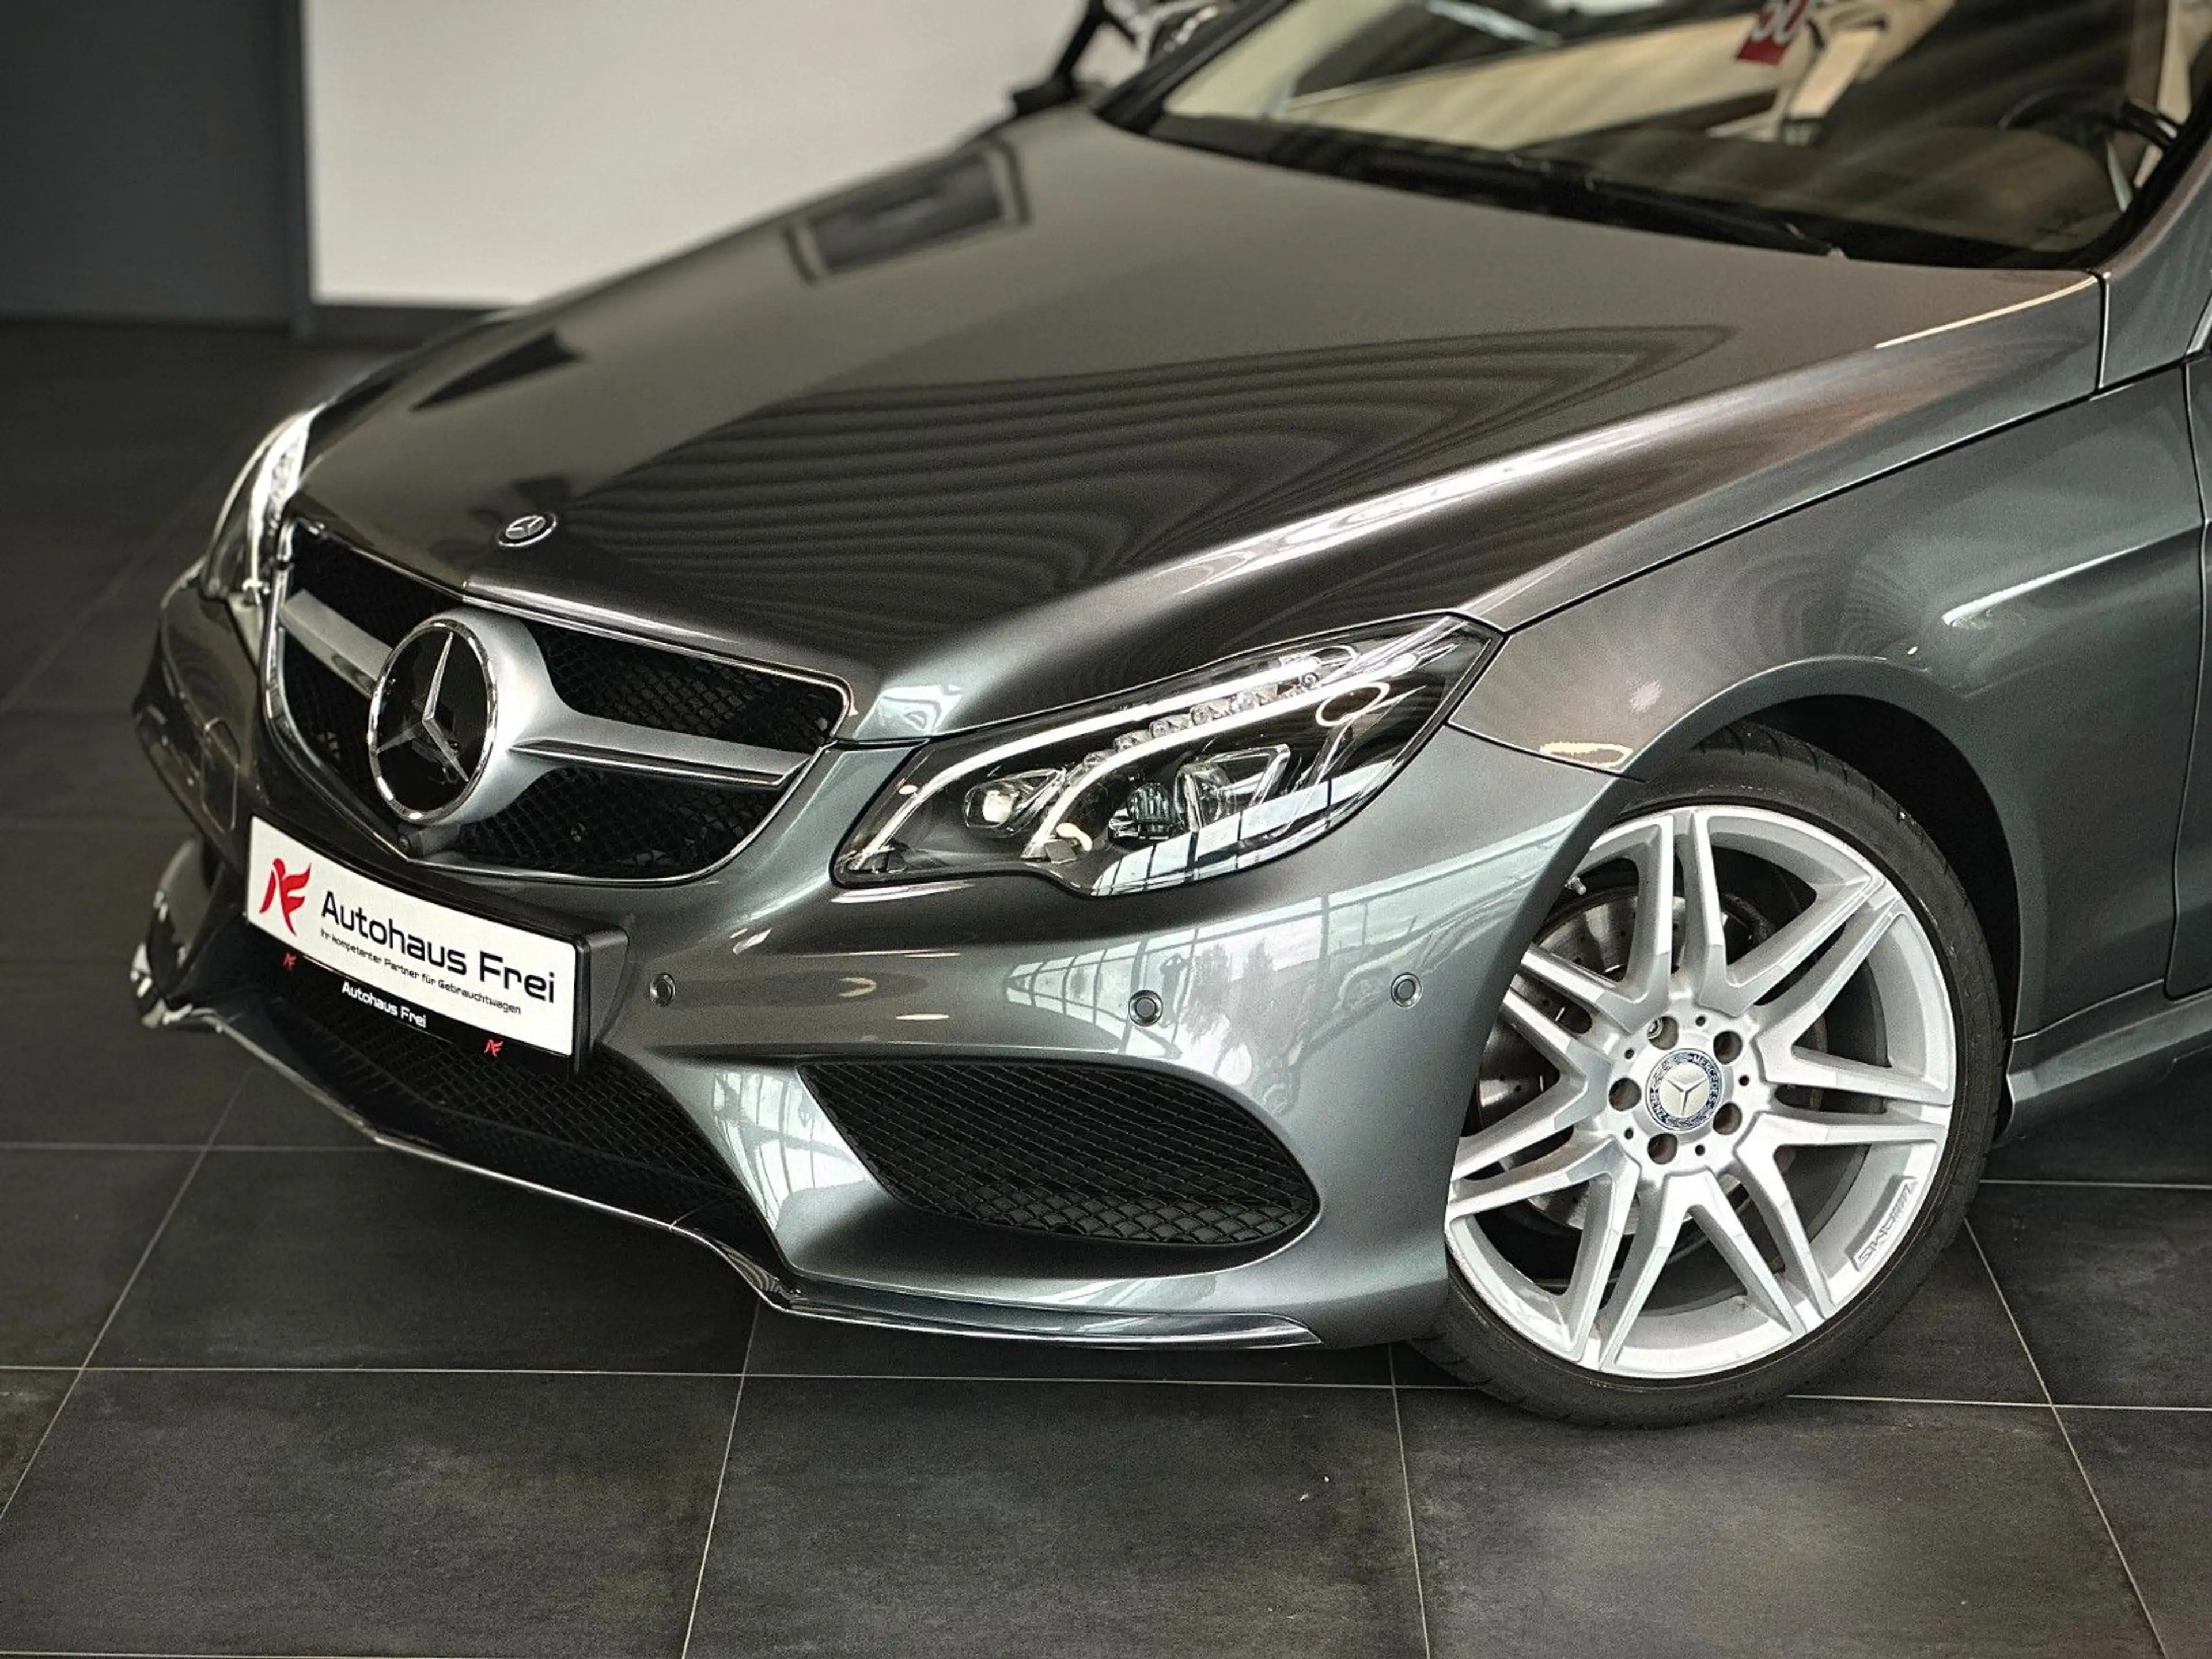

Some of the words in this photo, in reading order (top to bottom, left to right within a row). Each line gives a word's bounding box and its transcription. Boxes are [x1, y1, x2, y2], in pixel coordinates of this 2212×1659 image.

[321, 891, 467, 975] Autohaus
[480, 951, 554, 1003] Frei
[321, 928, 331, 940] Ihr
[332, 934, 382, 963] kompetenter
[384, 957, 419, 979] Partner
[422, 973, 436, 985] für
[438, 980, 521, 1014] Gebrauchtwagen
[342, 981, 398, 1016] Autohaus
[400, 1006, 427, 1028] Frei
[1692, 1054, 1719, 1105] MERCEDES
[1650, 1092, 1669, 1122] BENZ
